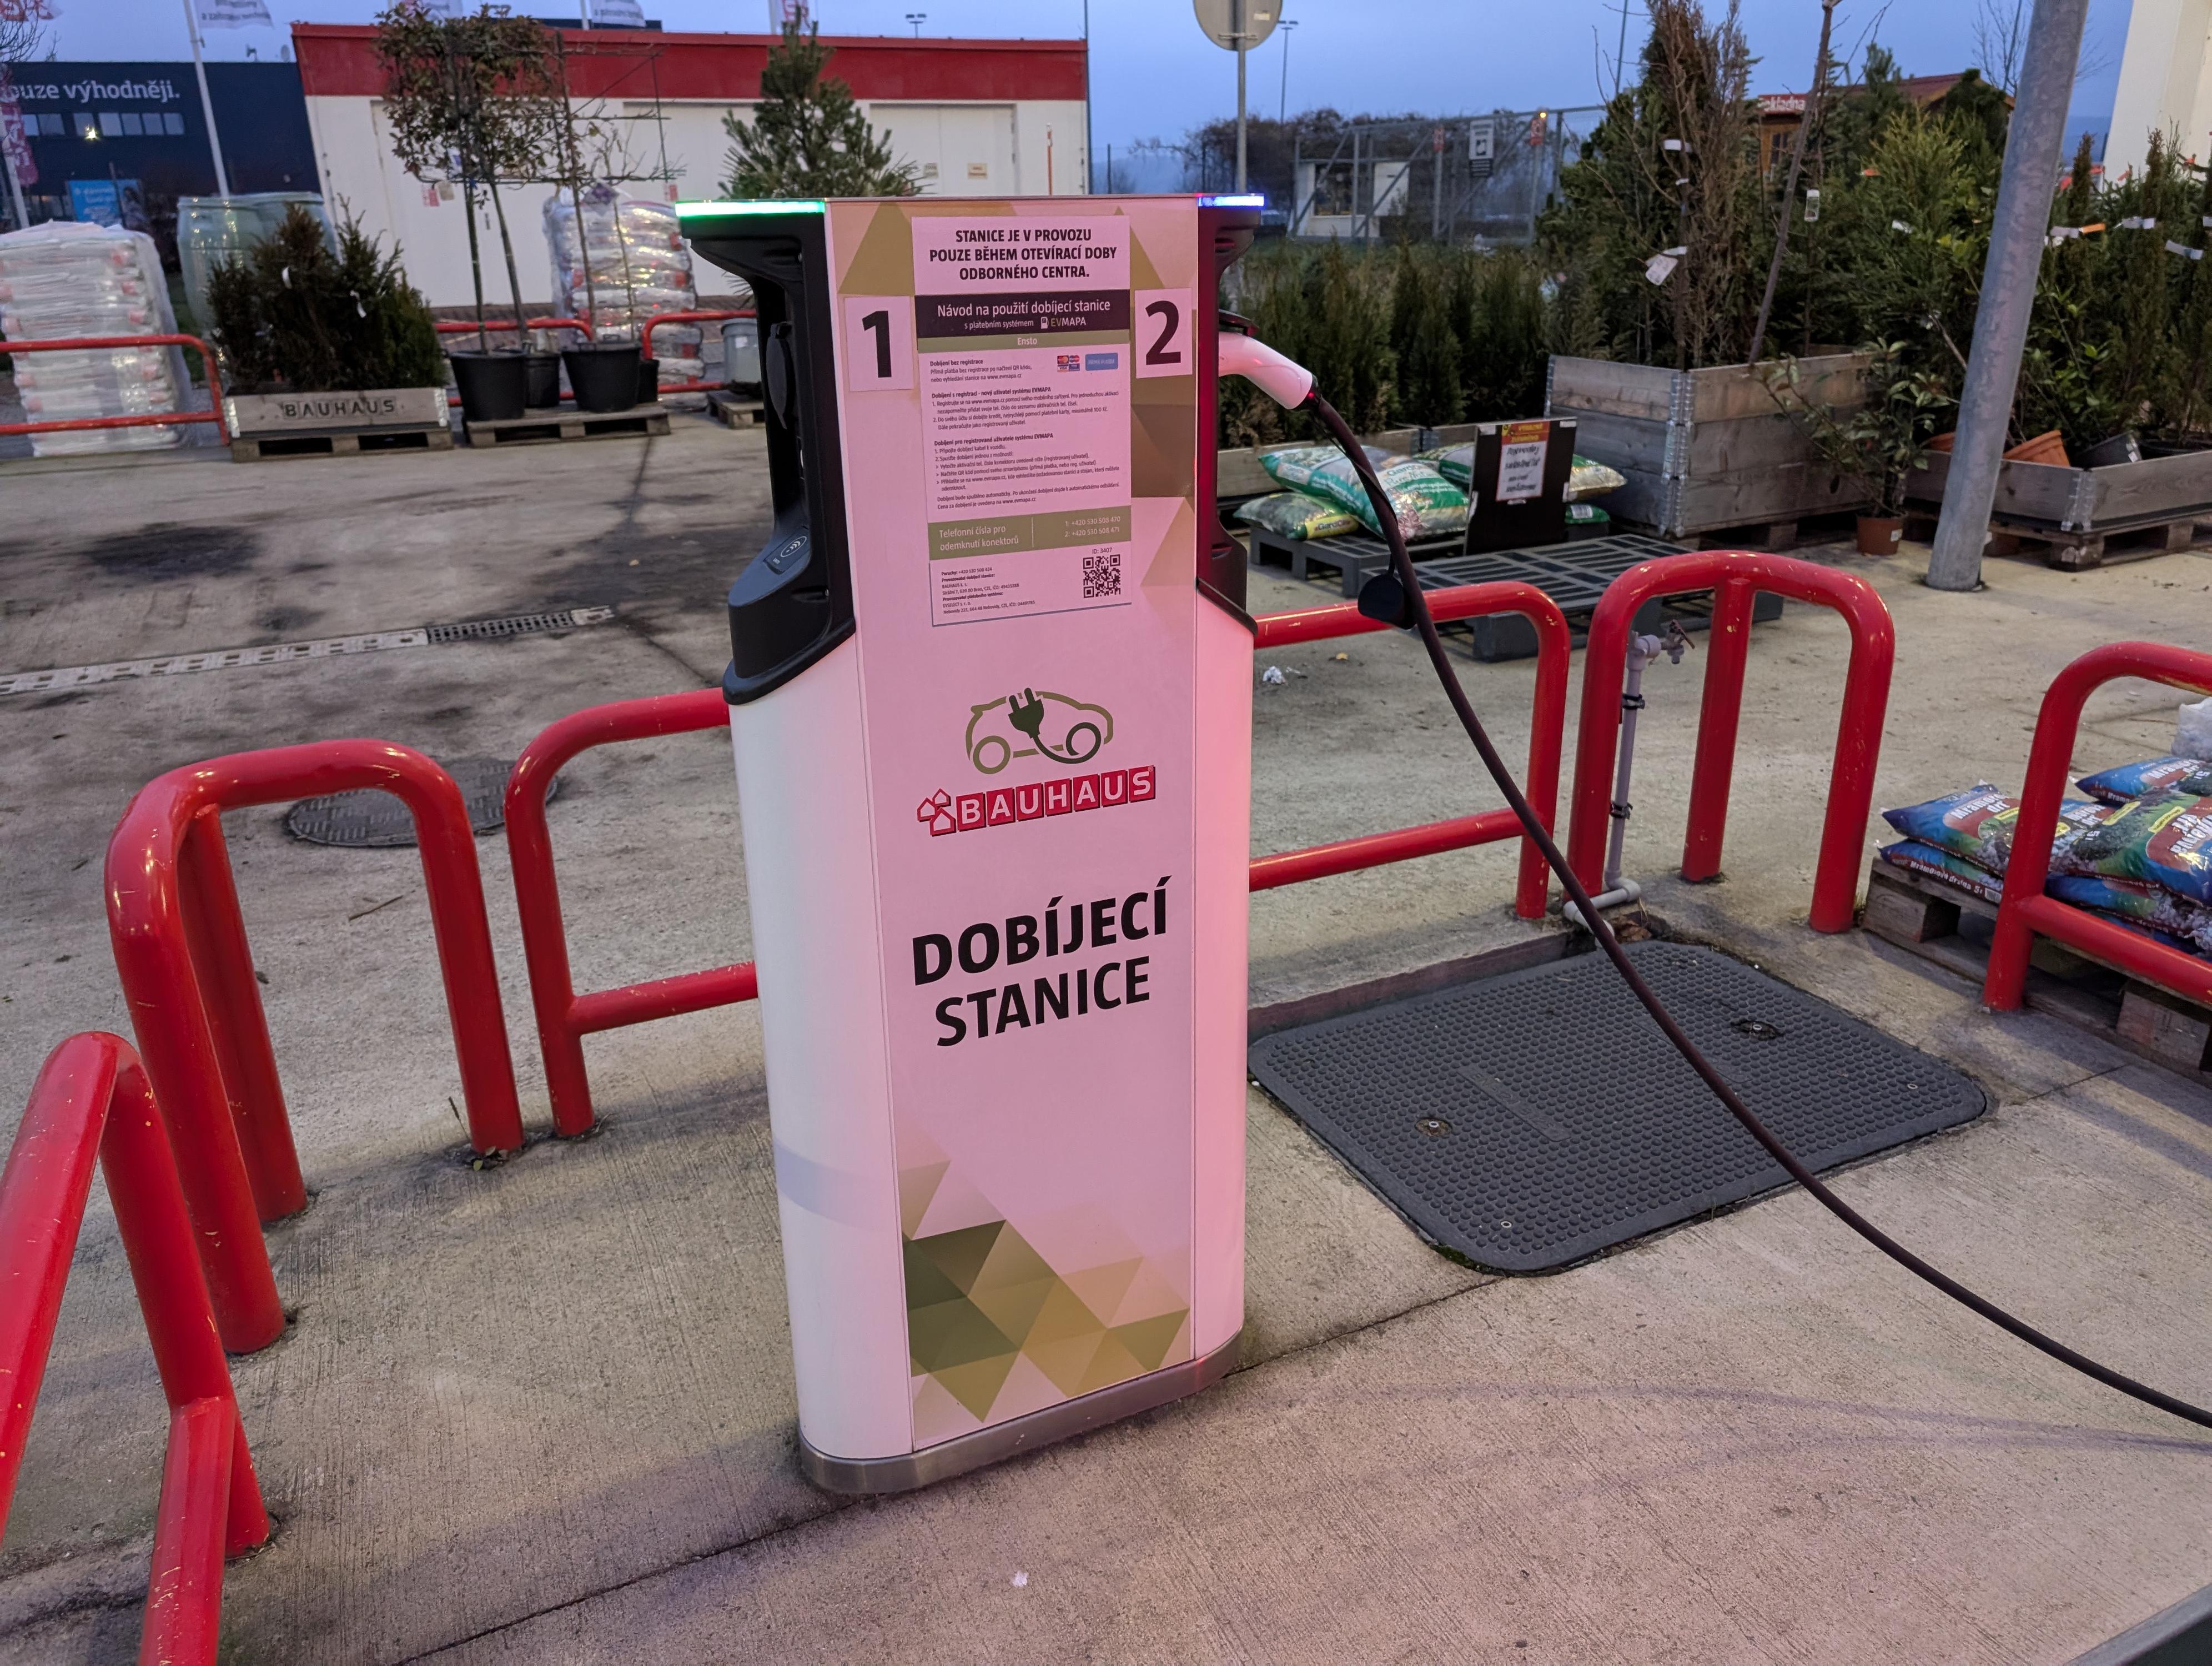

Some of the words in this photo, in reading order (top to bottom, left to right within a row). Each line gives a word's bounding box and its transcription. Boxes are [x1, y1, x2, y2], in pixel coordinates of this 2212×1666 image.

[10, 81, 59, 100] ouze
[63, 79, 180, 104] výhodněji.
[956, 229, 1004, 243] STANICE
[1008, 229, 1020, 242] JE
[1023, 229, 1031, 242] V
[1035, 229, 1092, 242] PROVOZU
[929, 249, 971, 262] POUZE
[975, 245, 1018, 261] BĚHEM
[1021, 244, 1082, 260] OTEVÍRACÍ
[1085, 247, 1117, 259] DOBY
[959, 264, 1038, 280] ODBORNÉHO
[1042, 265, 1090, 278] CENTRA.
[937, 303, 972, 317] Návod
[976, 305, 989, 316] na
[993, 302, 1029, 318] použití
[1031, 300, 1072, 315] dobíjecí
[1074, 299, 1110, 312] stanice
[969, 320, 1002, 331] platebním
[1003, 319, 1034, 330] systémem
[1050, 317, 1087, 327] EVMAPA
[1144, 300, 1182, 366] 2
[862, 310, 892, 378] 1
[1017, 337, 1038, 345] Ensto
[284, 399, 395, 417] BAUHAUS
[939, 528, 973, 538] Telefonní
[976, 526, 991, 535] čísla
[993, 526, 1006, 535] pro
[940, 539, 980, 551] odemknutí
[982, 535, 1019, 547] konektorů
[958, 769, 1154, 829] BAUHAUS
[912, 875, 1173, 986] DOBÍJECÍ
[935, 955, 1150, 1047] STANICE
